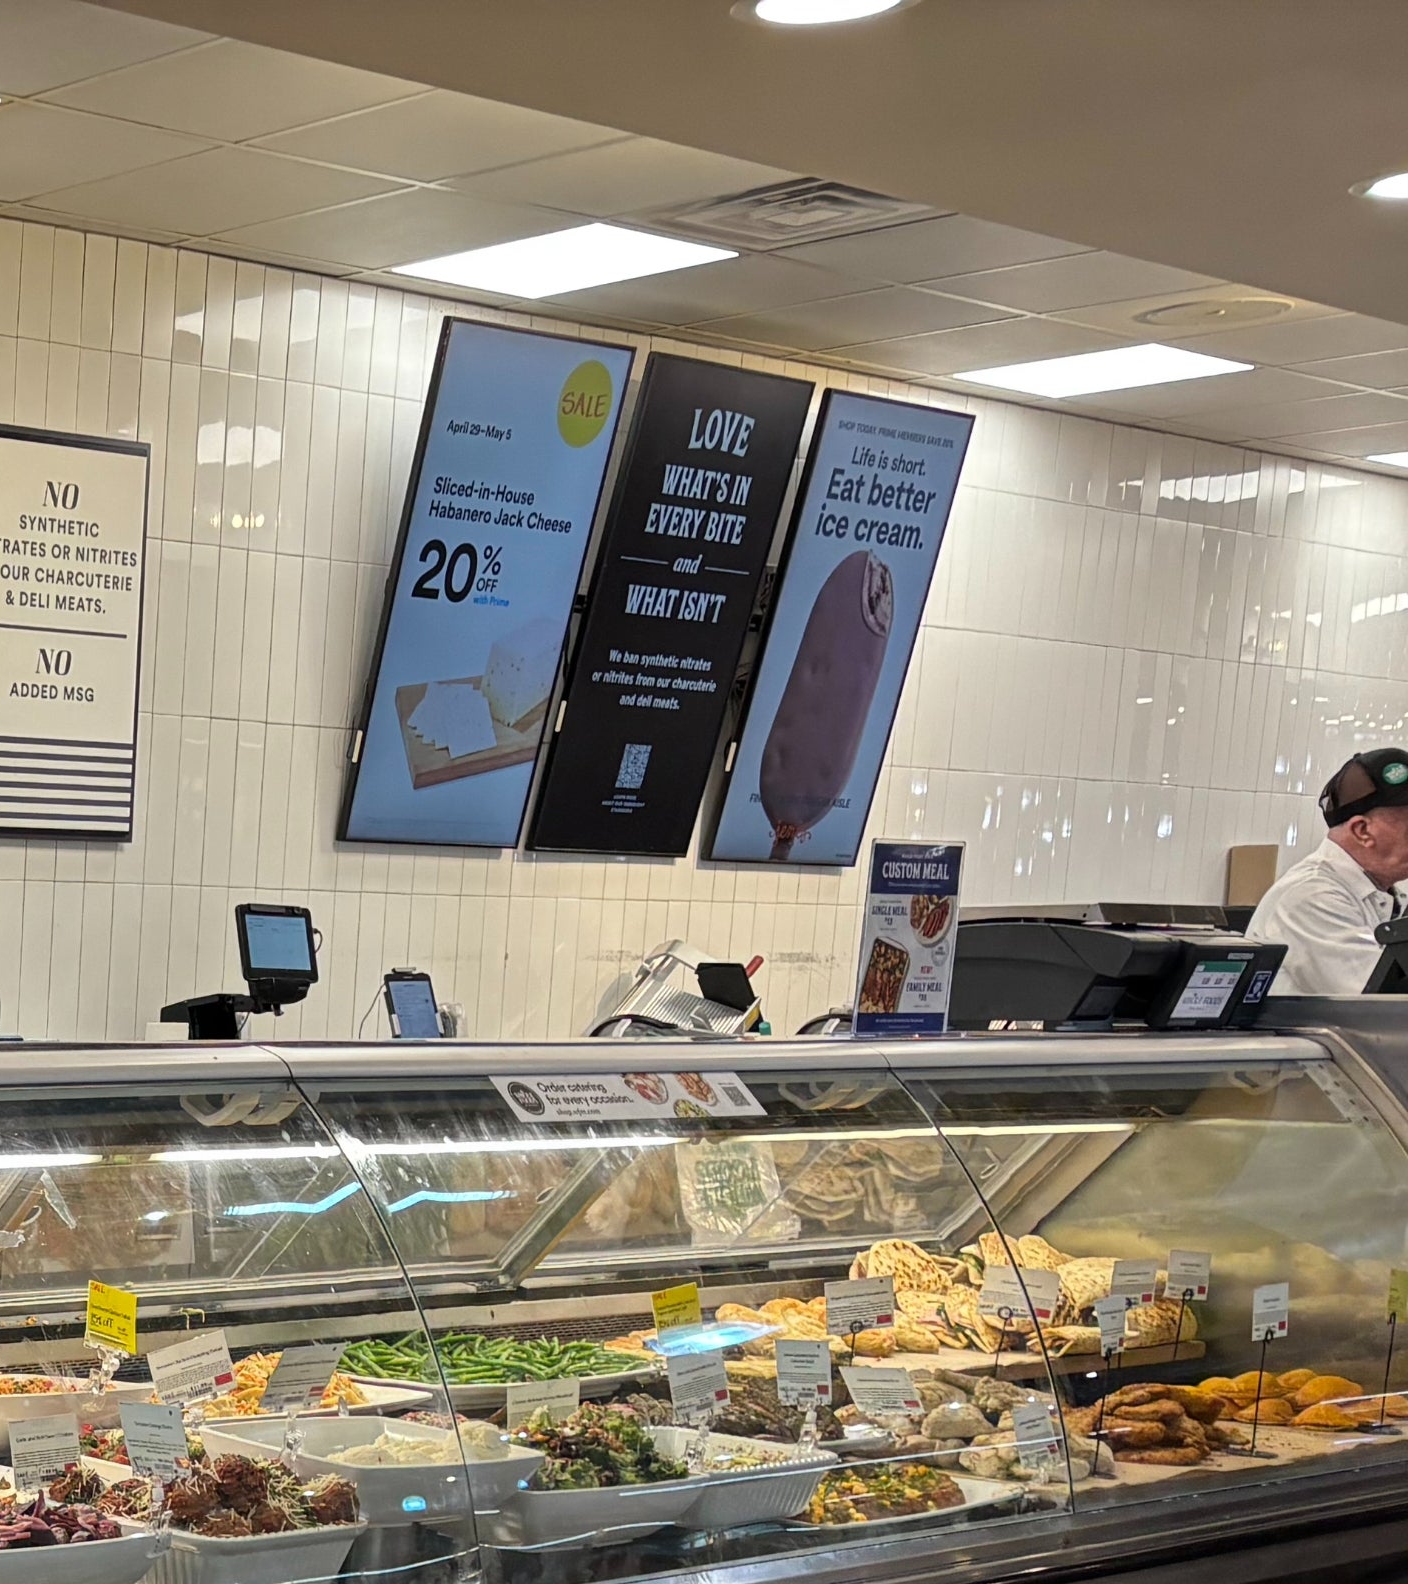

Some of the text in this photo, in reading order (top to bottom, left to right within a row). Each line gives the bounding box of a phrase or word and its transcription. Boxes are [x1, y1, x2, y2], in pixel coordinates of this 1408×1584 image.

[561, 392, 606, 419] SALE
[447, 419, 470, 437] April
[505, 428, 512, 440] 5
[688, 408, 756, 458] LOVE
[851, 446, 926, 476] Life is short.
[42, 480, 80, 510] NO
[433, 476, 535, 507] Sliced-in-House
[662, 464, 753, 506] WHAT'S IN
[826, 468, 937, 514] Eat better
[19, 514, 99, 538] SYNTHETIC
[428, 500, 572, 534] Habanero Jack Cheese
[645, 503, 746, 546] EVERY BITE
[815, 503, 923, 549] ice cream.
[52, 544, 70, 560] OR
[75, 546, 137, 567] NITRITES
[673, 555, 702, 576] and
[0, 565, 30, 581] OUR
[35, 568, 133, 592] CHARCUTERIE
[476, 577, 499, 593] OFF
[5, 590, 106, 614] & DELI MEATS.
[624, 583, 726, 624] WHAT ISN'T
[36, 648, 71, 676] NO
[609, 650, 712, 671] We ban synthetic nitrates
[10, 682, 95, 702] ADDED MSG
[592, 670, 717, 693] or nitrites from our charcuterie
[619, 694, 636, 706] and
[883, 861, 950, 880] CUSTOM MEAL
[537, 1082, 607, 1094] Order catering
[545, 1093, 635, 1107] for every occasion.
